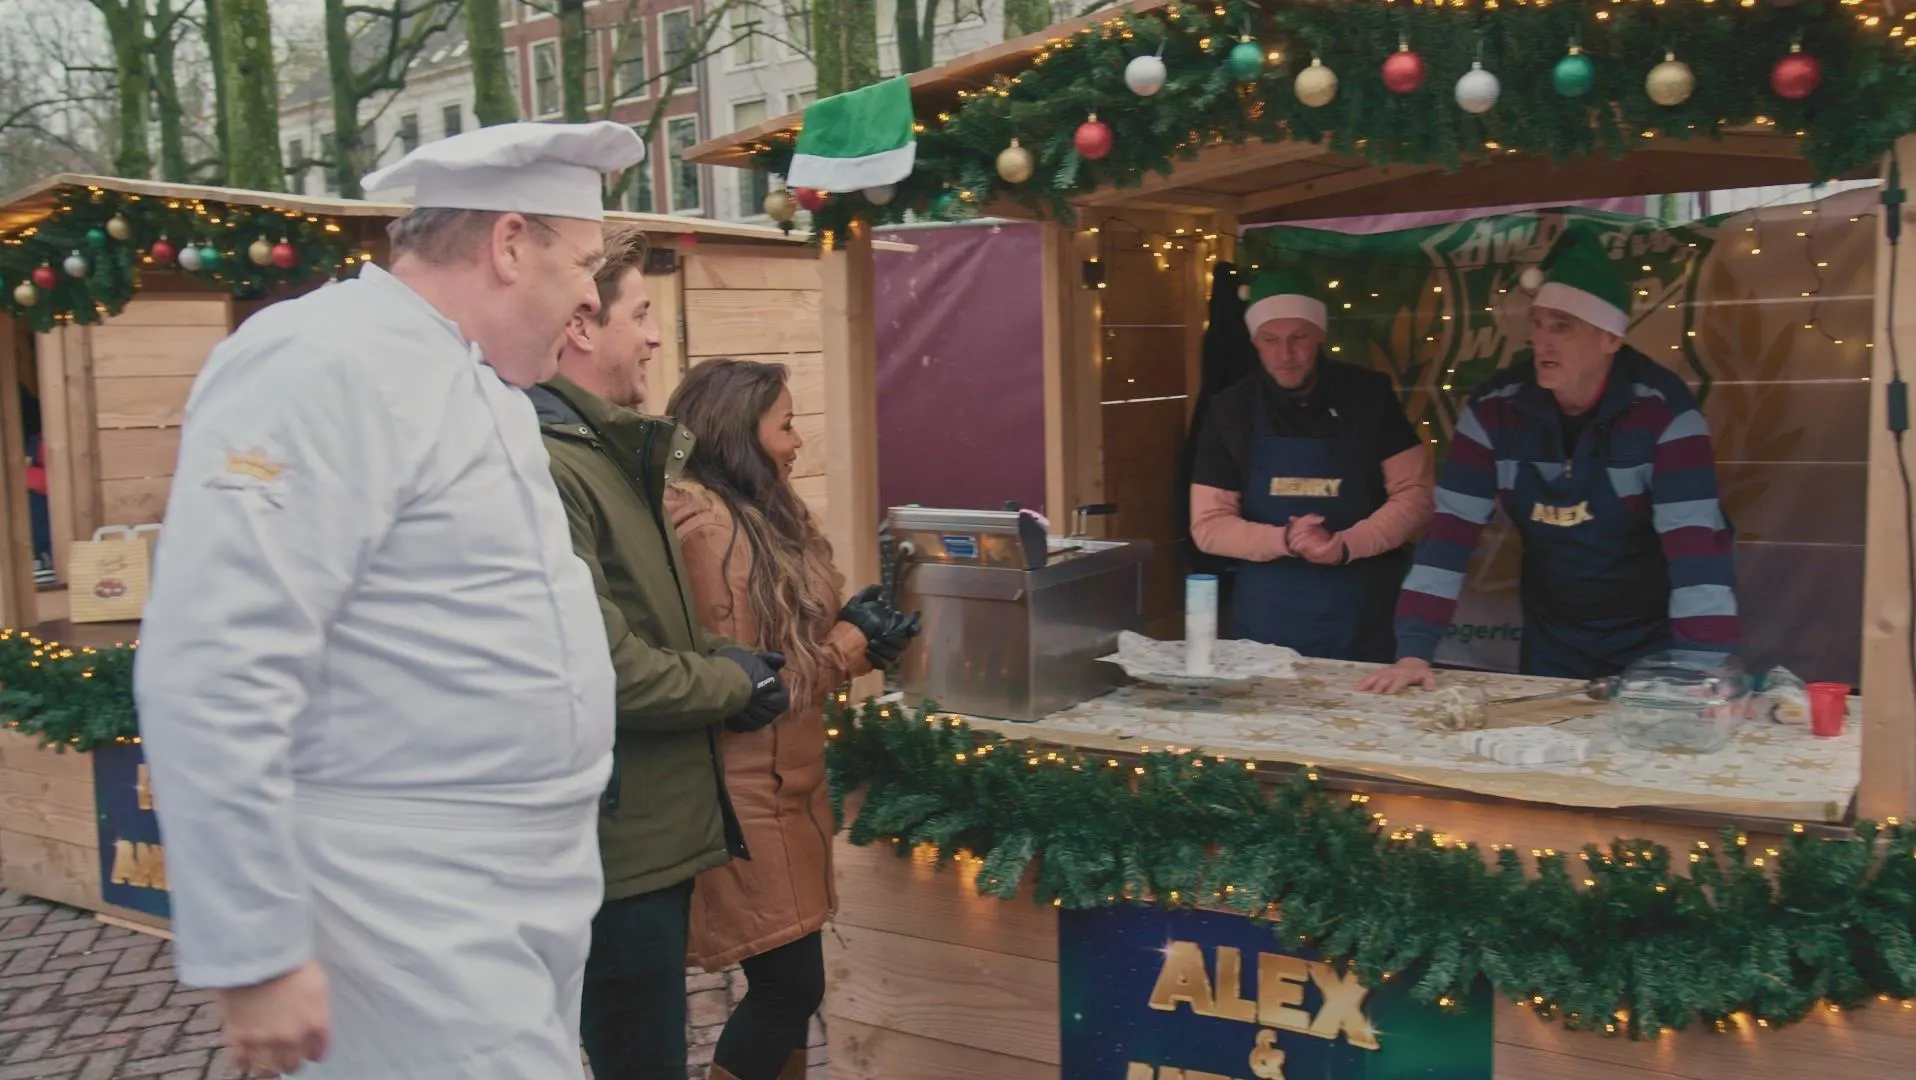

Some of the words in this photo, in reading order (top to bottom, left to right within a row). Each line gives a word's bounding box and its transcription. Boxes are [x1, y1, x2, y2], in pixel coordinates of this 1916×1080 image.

[1269, 477, 1343, 496] HENRY
[1530, 500, 1595, 526] ALEX
[1148, 940, 1381, 1050] ALEX
[1248, 1028, 1286, 1080] &
